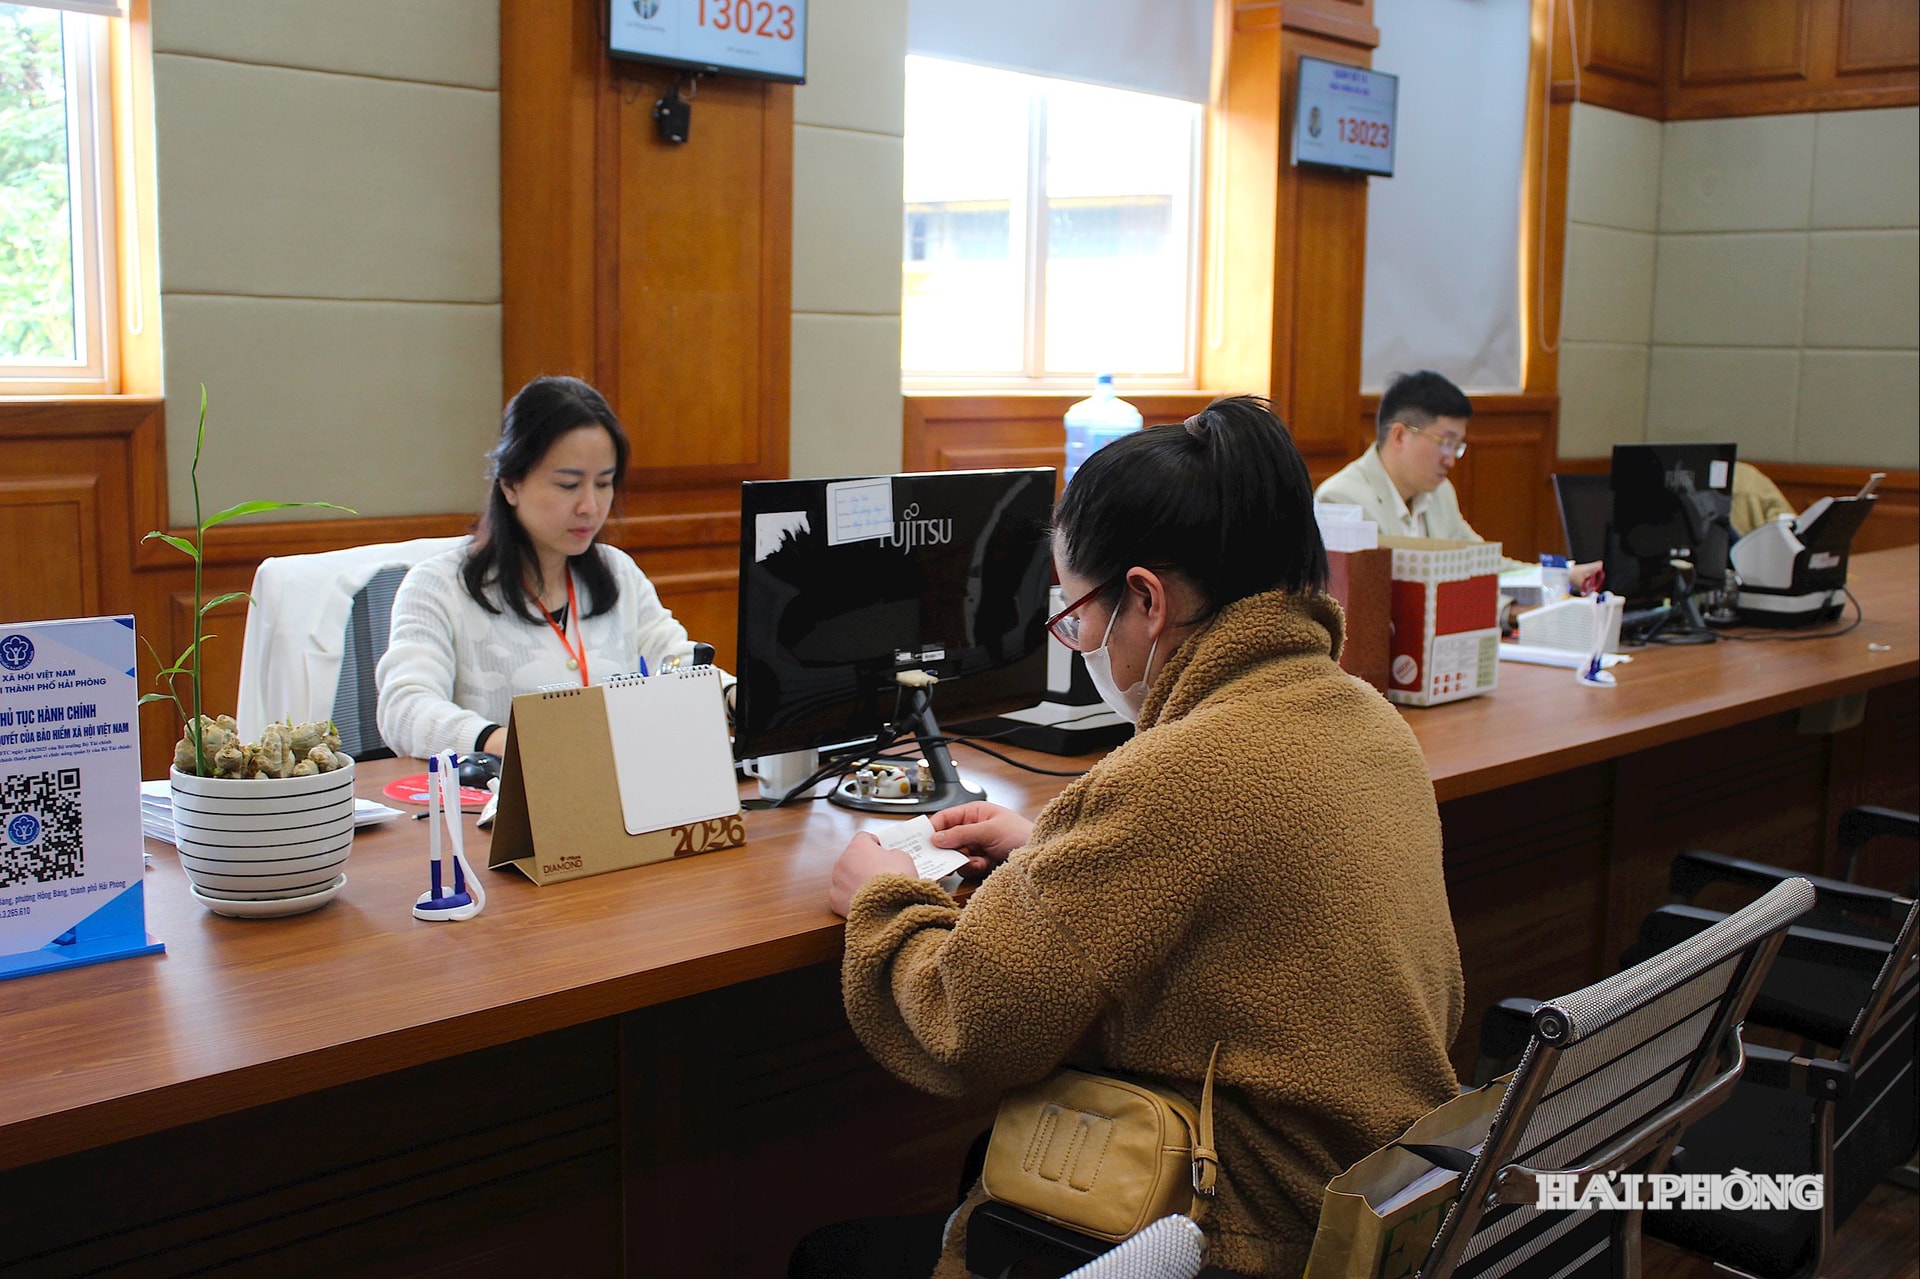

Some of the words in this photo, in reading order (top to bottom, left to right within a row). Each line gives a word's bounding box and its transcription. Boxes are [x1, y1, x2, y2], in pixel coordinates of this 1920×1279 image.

[698, 0, 795, 40] 13023
[1338, 118, 1390, 149] 13023
[2, 673, 15, 682] XÃ
[17, 671, 34, 682] HỘI
[36, 669, 54, 680] VIỆT
[56, 669, 76, 677] NAM
[5, 683, 35, 694] THÀNH
[37, 679, 56, 691] PHỐ
[58, 679, 74, 689] HẢI
[75, 677, 107, 687] PHÒNG
[0, 707, 14, 727] HỦ
[16, 709, 35, 728] TỤC
[37, 705, 65, 723] HÀNH
[67, 702, 97, 720] CHÍNH
[0, 730, 18, 747] UYẾT
[20, 729, 35, 744] CỦA
[36, 727, 51, 742] BẢO
[53, 724, 71, 740] HIỂM
[72, 724, 83, 738] XÃ
[83, 723, 96, 739] HỘI
[97, 722, 112, 738] VIỆT
[113, 722, 130, 734] NAM
[671, 814, 745, 856] 2026
[543, 859, 583, 874] DIAMOND
[0, 906, 31, 918] .3.265.610
